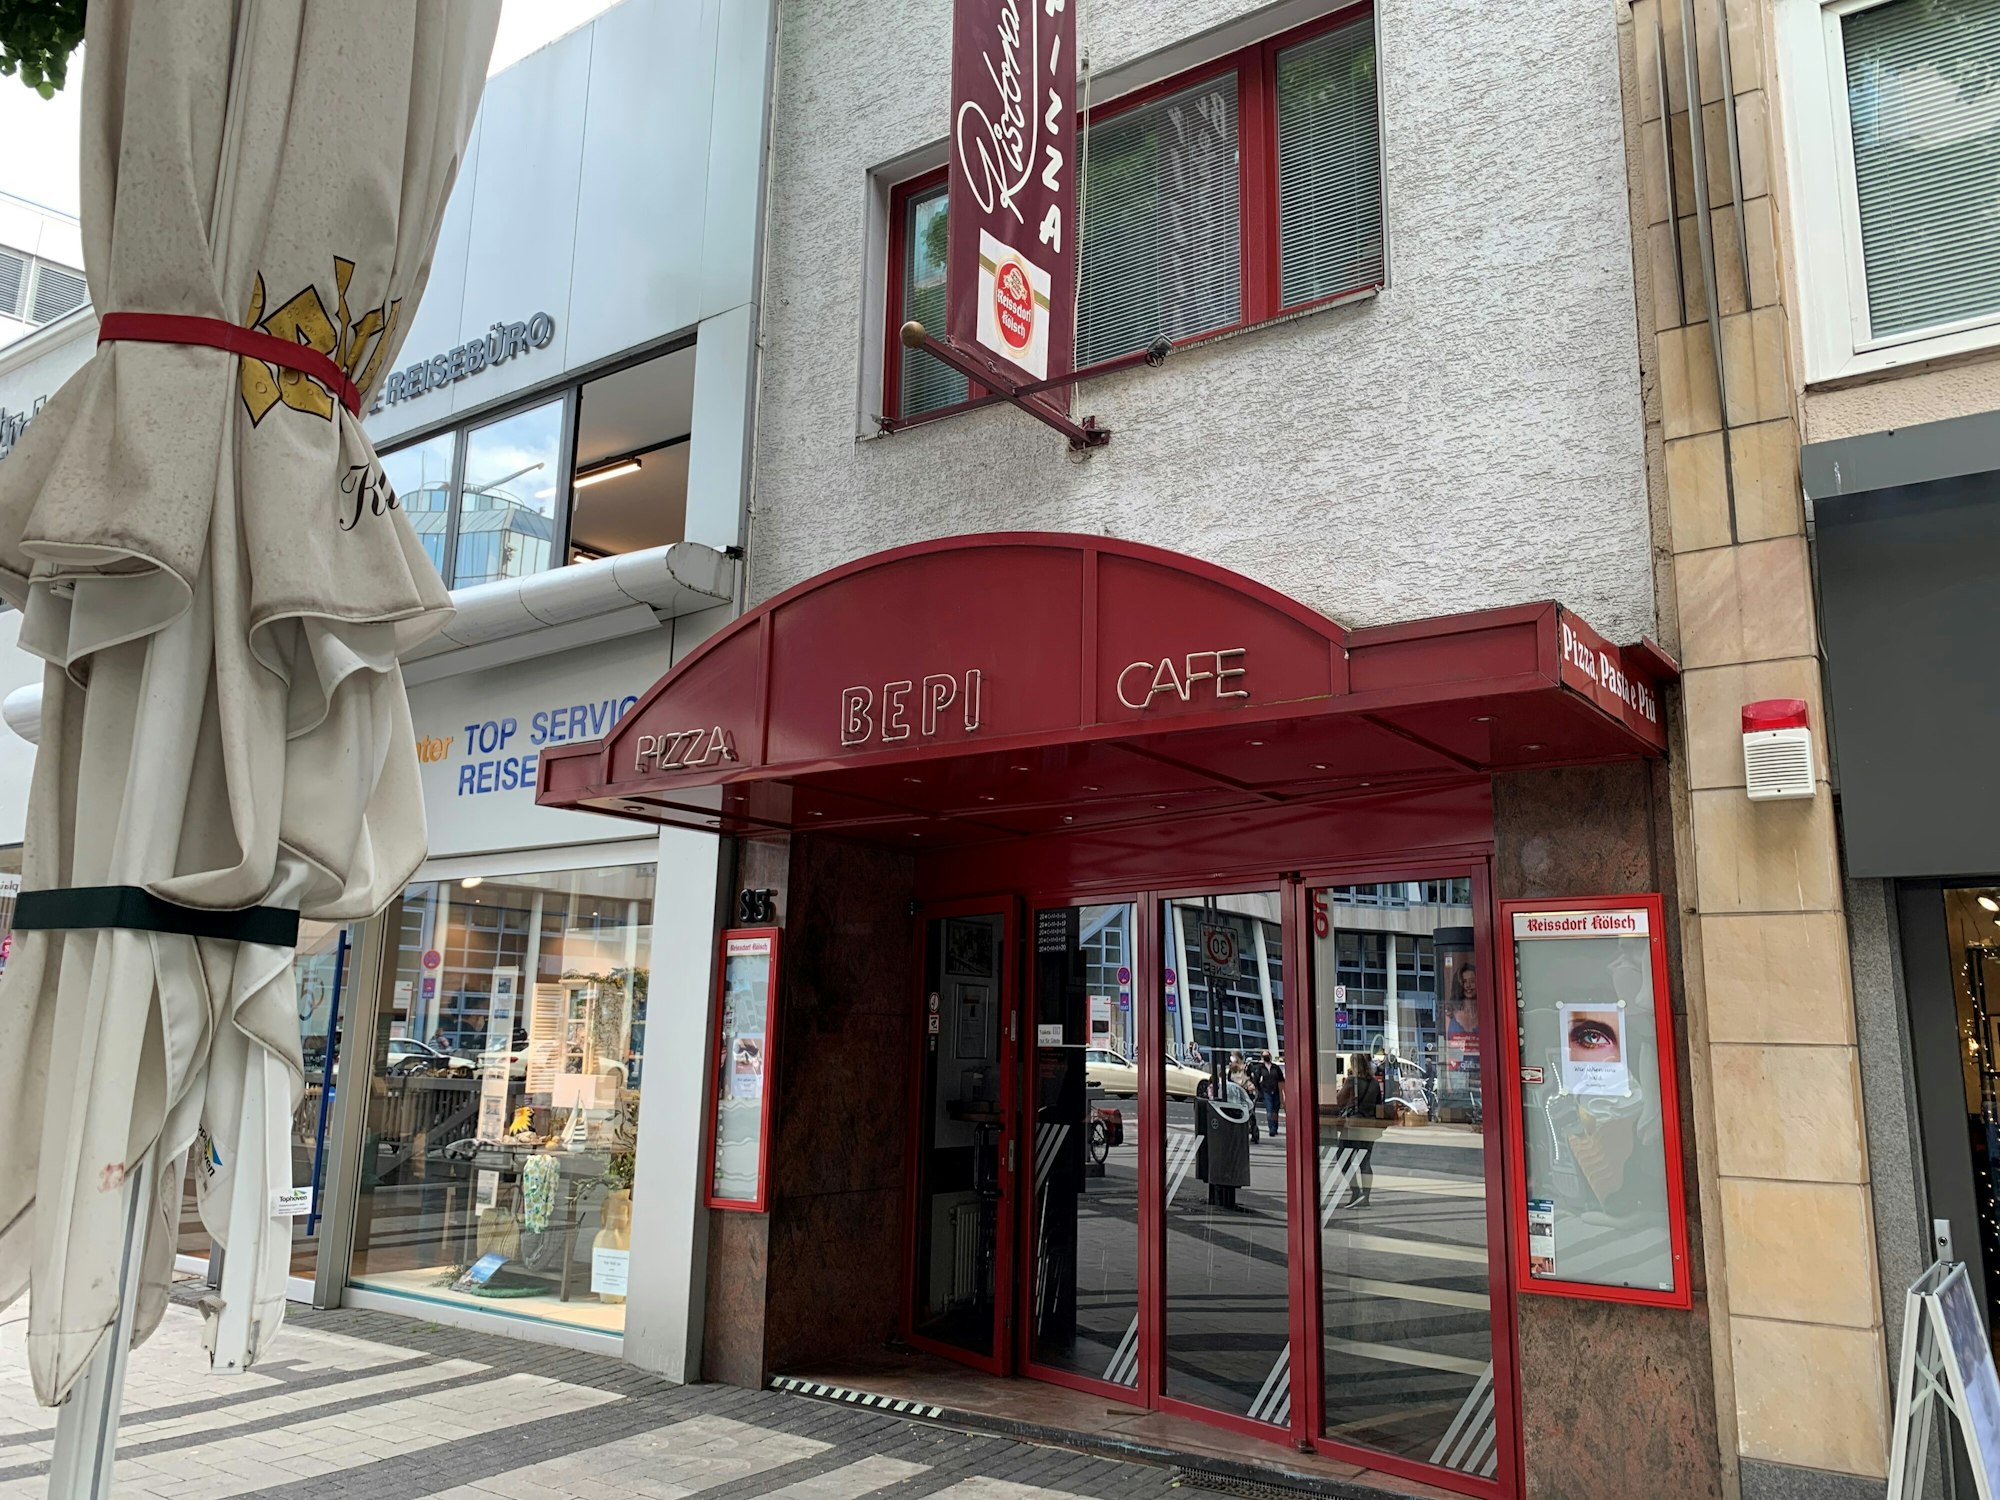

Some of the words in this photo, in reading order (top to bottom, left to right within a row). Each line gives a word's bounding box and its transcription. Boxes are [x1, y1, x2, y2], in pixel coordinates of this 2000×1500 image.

[997, 288, 1031, 322] Reissdorf
[1002, 310, 1026, 339] Kölsch
[385, 311, 551, 405] REISEBÜRO
[1116, 648, 1250, 709] CAFE
[1562, 623, 1599, 685] Pizza,
[1599, 651, 1630, 705] Pasta
[1630, 685, 1637, 710] e
[841, 669, 981, 747] BEPI
[464, 718, 517, 755] TOP
[635, 726, 735, 773] PIZZA
[458, 754, 538, 796] REISE
[1527, 917, 1588, 931] Reissdorf
[1591, 914, 1636, 931] Kölsch
